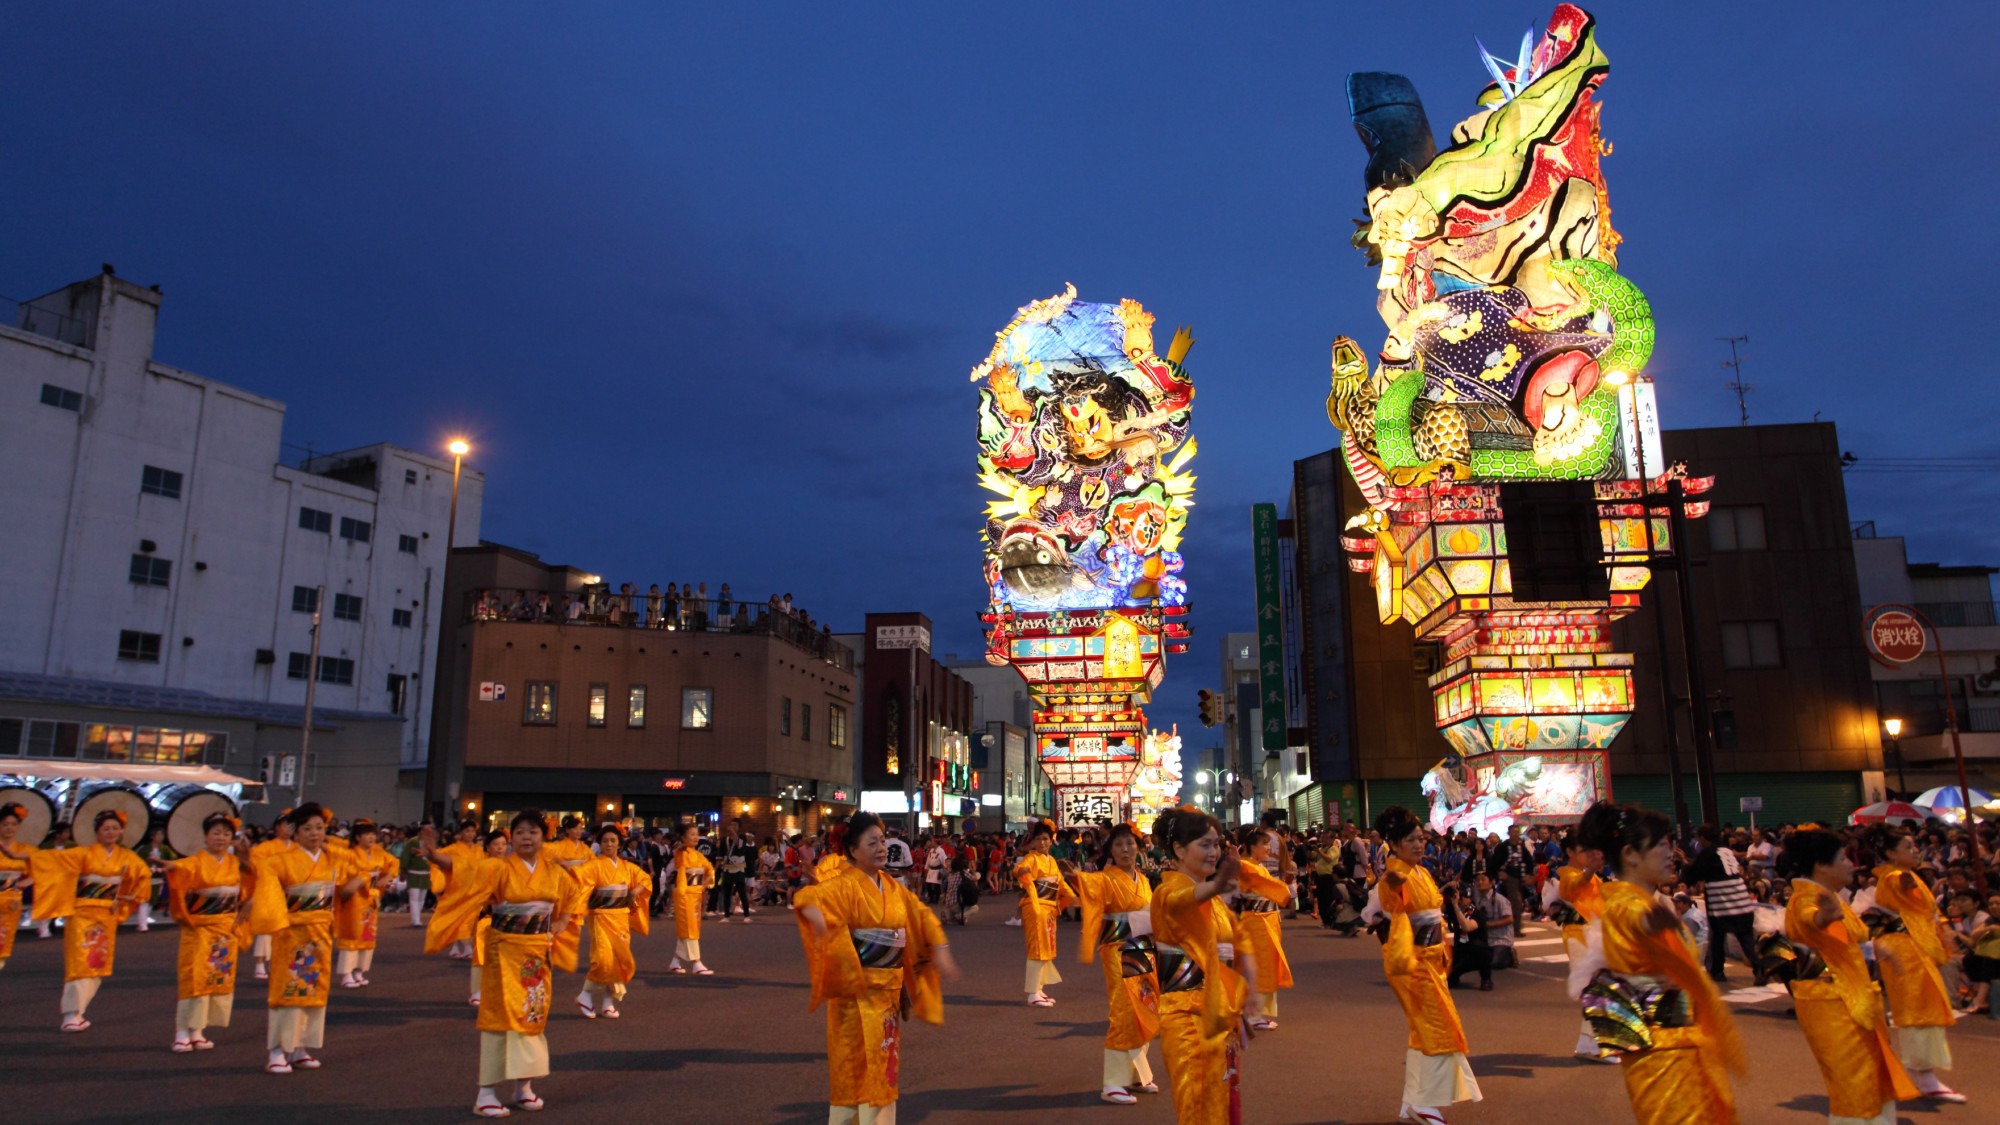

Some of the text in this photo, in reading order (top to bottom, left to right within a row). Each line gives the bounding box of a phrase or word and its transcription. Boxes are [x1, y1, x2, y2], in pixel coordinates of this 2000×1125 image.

[1645, 402, 1655, 436] 青森県
[1876, 626, 1921, 647] 消火栓
[1259, 603, 1282, 733] 金正堂本店
[494, 684, 505, 699] P
